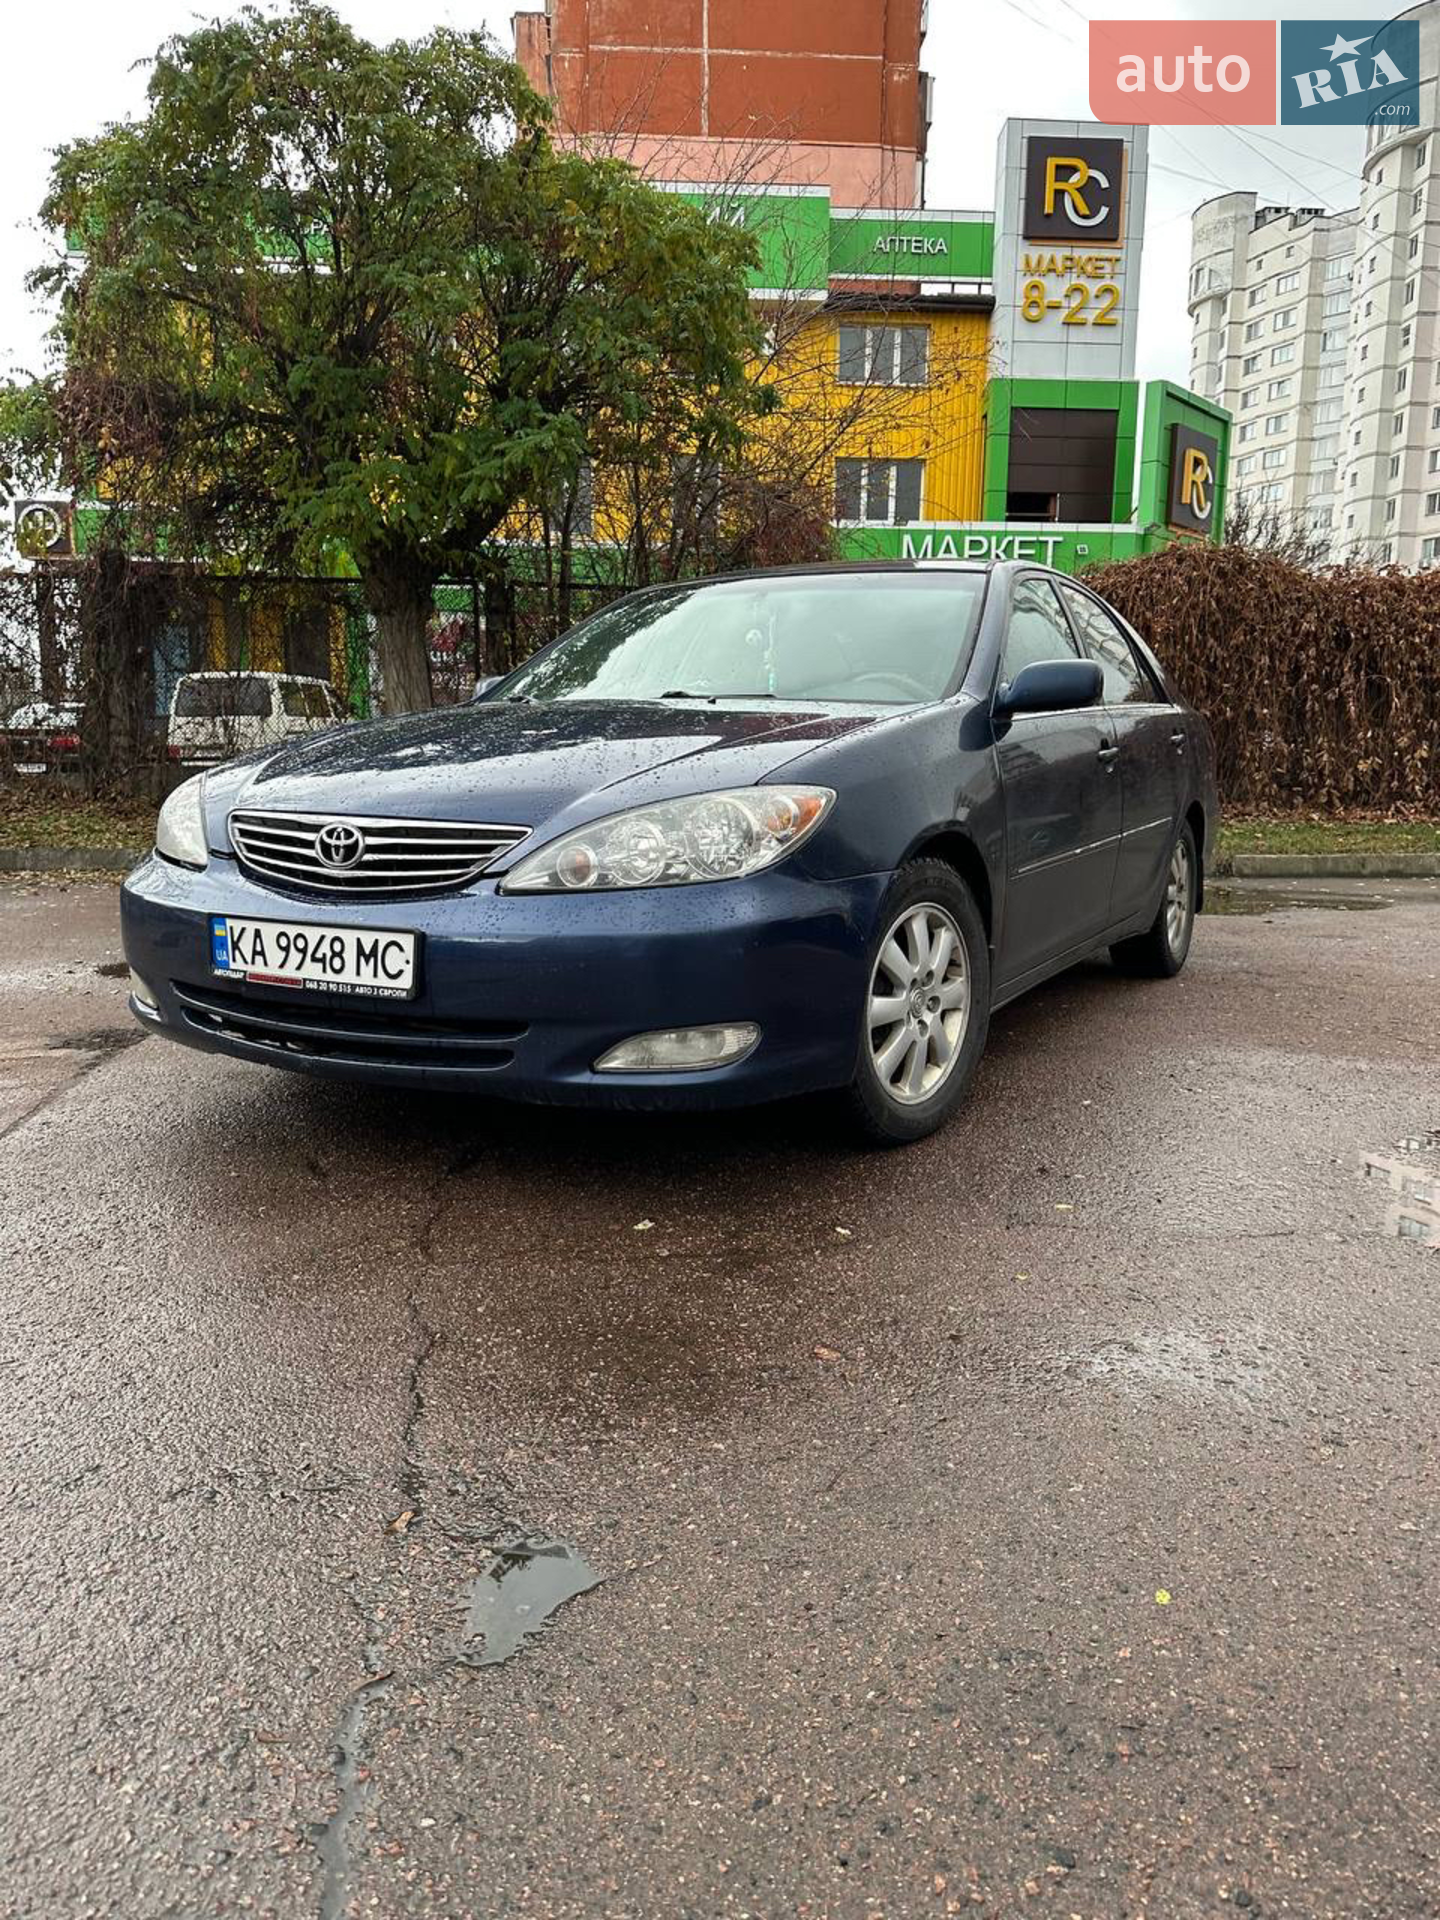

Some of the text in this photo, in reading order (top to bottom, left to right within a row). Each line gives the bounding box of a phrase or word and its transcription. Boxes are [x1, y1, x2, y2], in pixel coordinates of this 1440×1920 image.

[1044, 157, 1110, 227] RC
[872, 235, 948, 256] АПТЕКА
[1022, 253, 1122, 279] МАРКЕТ
[1021, 279, 1121, 326] 8-22
[902, 534, 1064, 567] МАРКЕТ
[229, 925, 406, 980] KA 9948 MC
